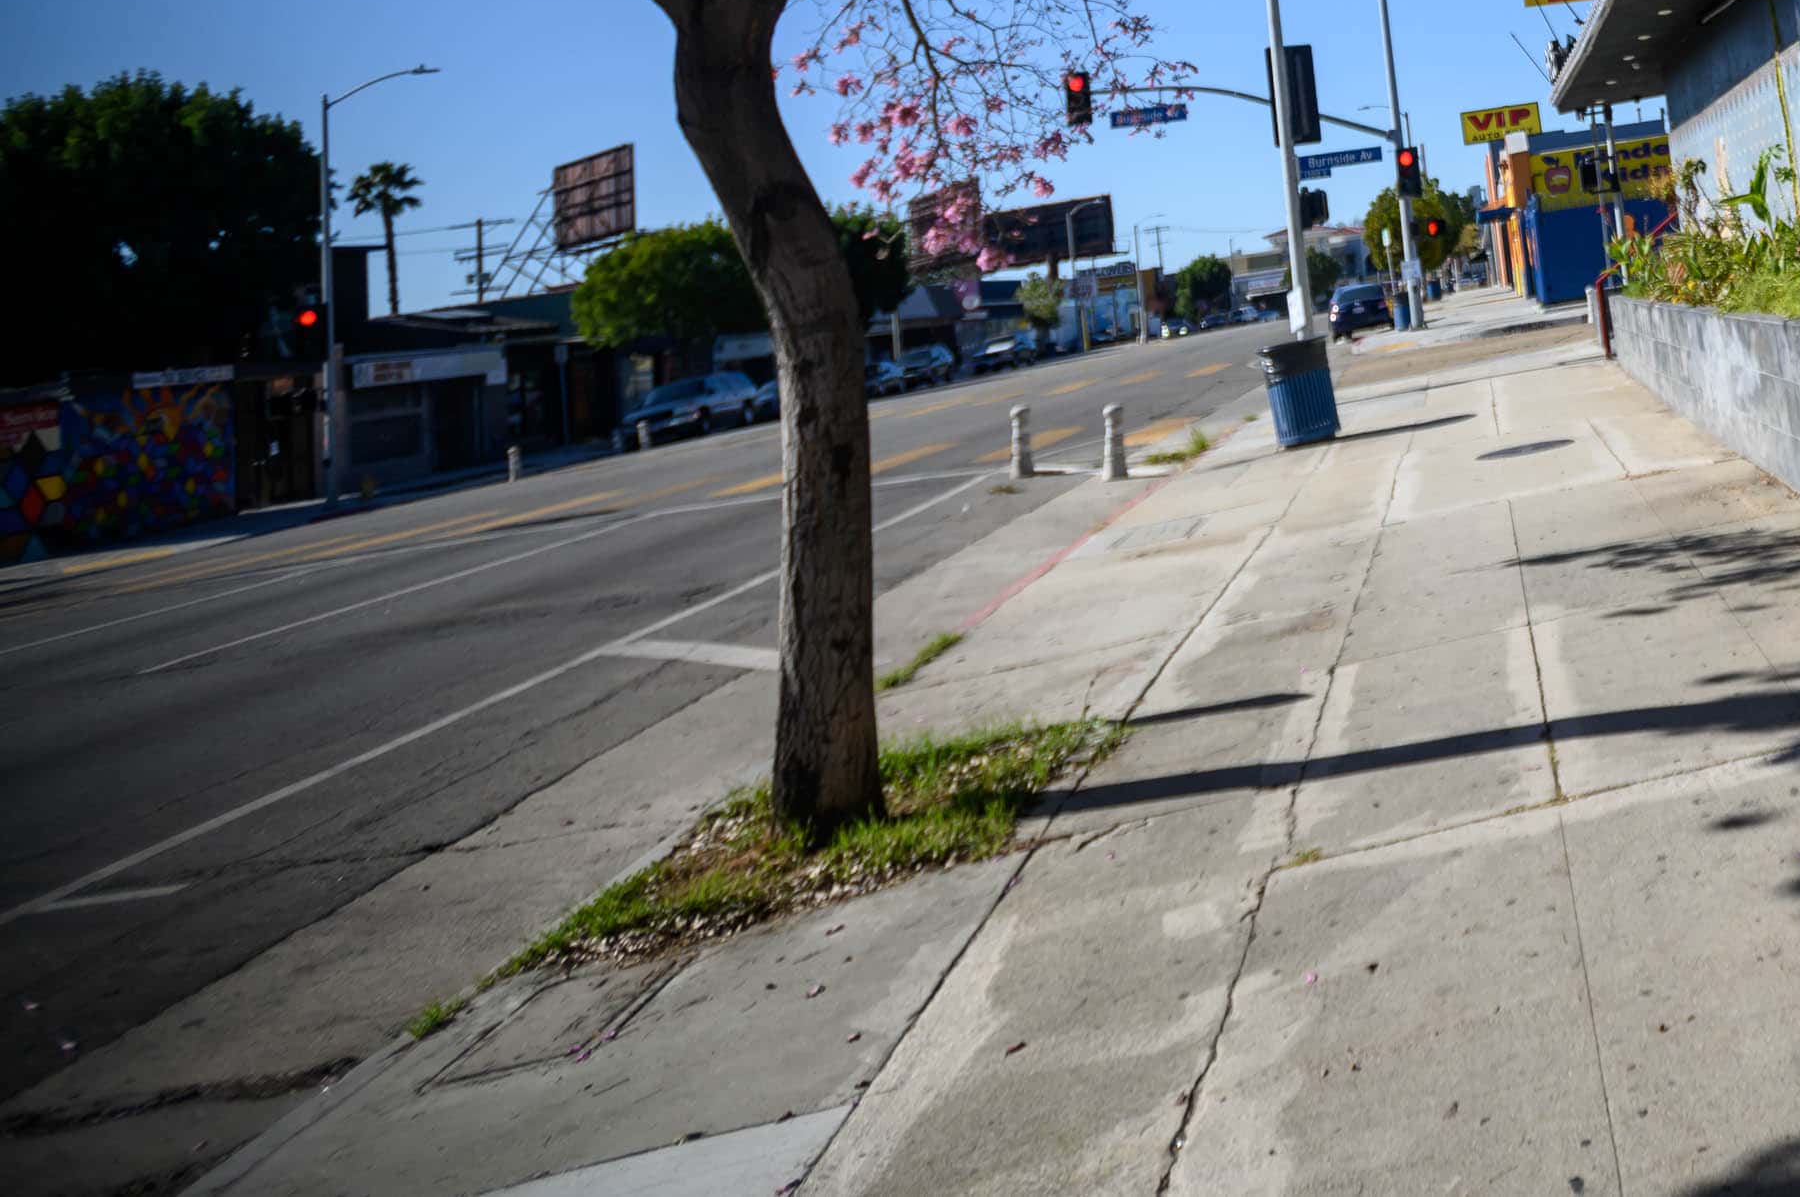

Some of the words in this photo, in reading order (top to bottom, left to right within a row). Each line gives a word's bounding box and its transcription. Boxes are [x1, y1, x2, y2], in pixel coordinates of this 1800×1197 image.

[1467, 108, 1531, 131] VIP
[1472, 132, 1501, 141] AUTO
[1307, 153, 1356, 168] Burnside
[1360, 151, 1373, 161] Av
